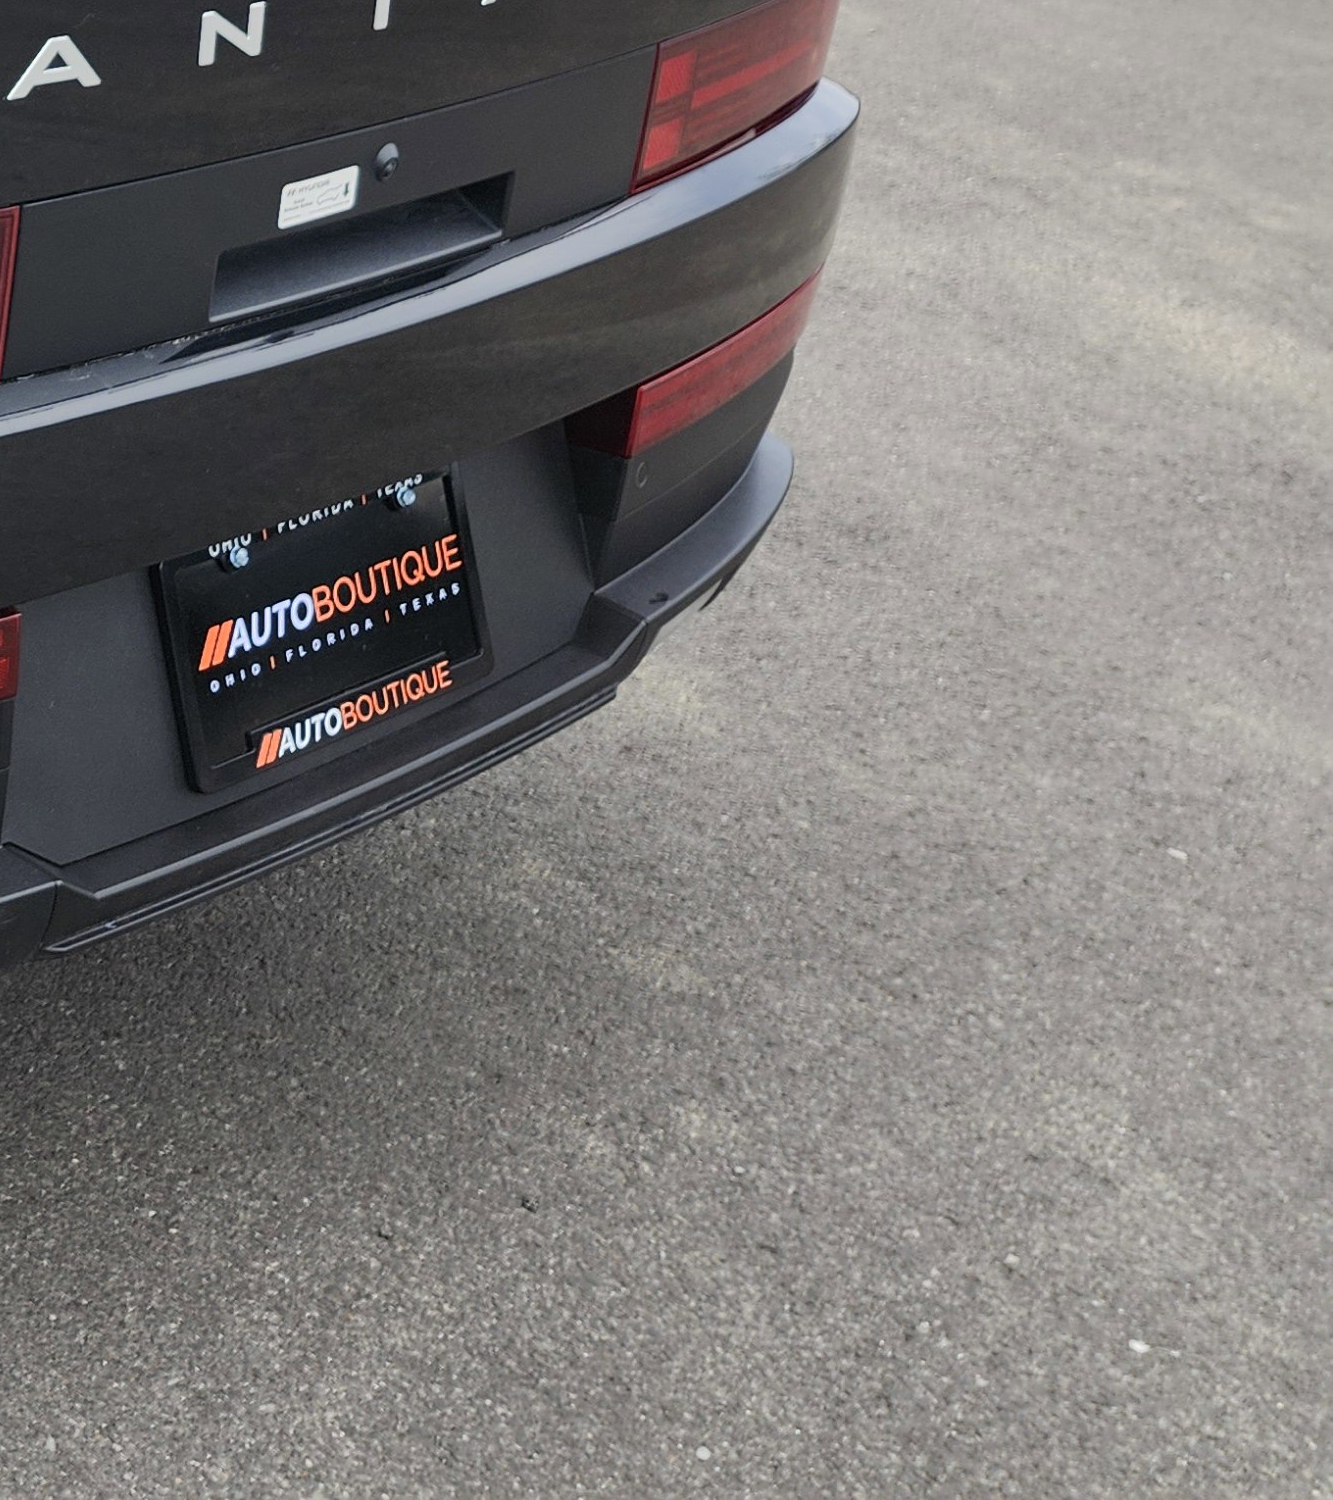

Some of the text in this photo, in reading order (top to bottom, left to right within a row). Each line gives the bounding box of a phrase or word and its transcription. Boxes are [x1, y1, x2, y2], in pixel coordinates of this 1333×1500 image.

[210, 581, 462, 693] OHIO FLORIDA TEXAS
[227, 534, 463, 659] AUTOBOUTIQUE
[277, 660, 454, 758] AUTOBOUTIQUE
